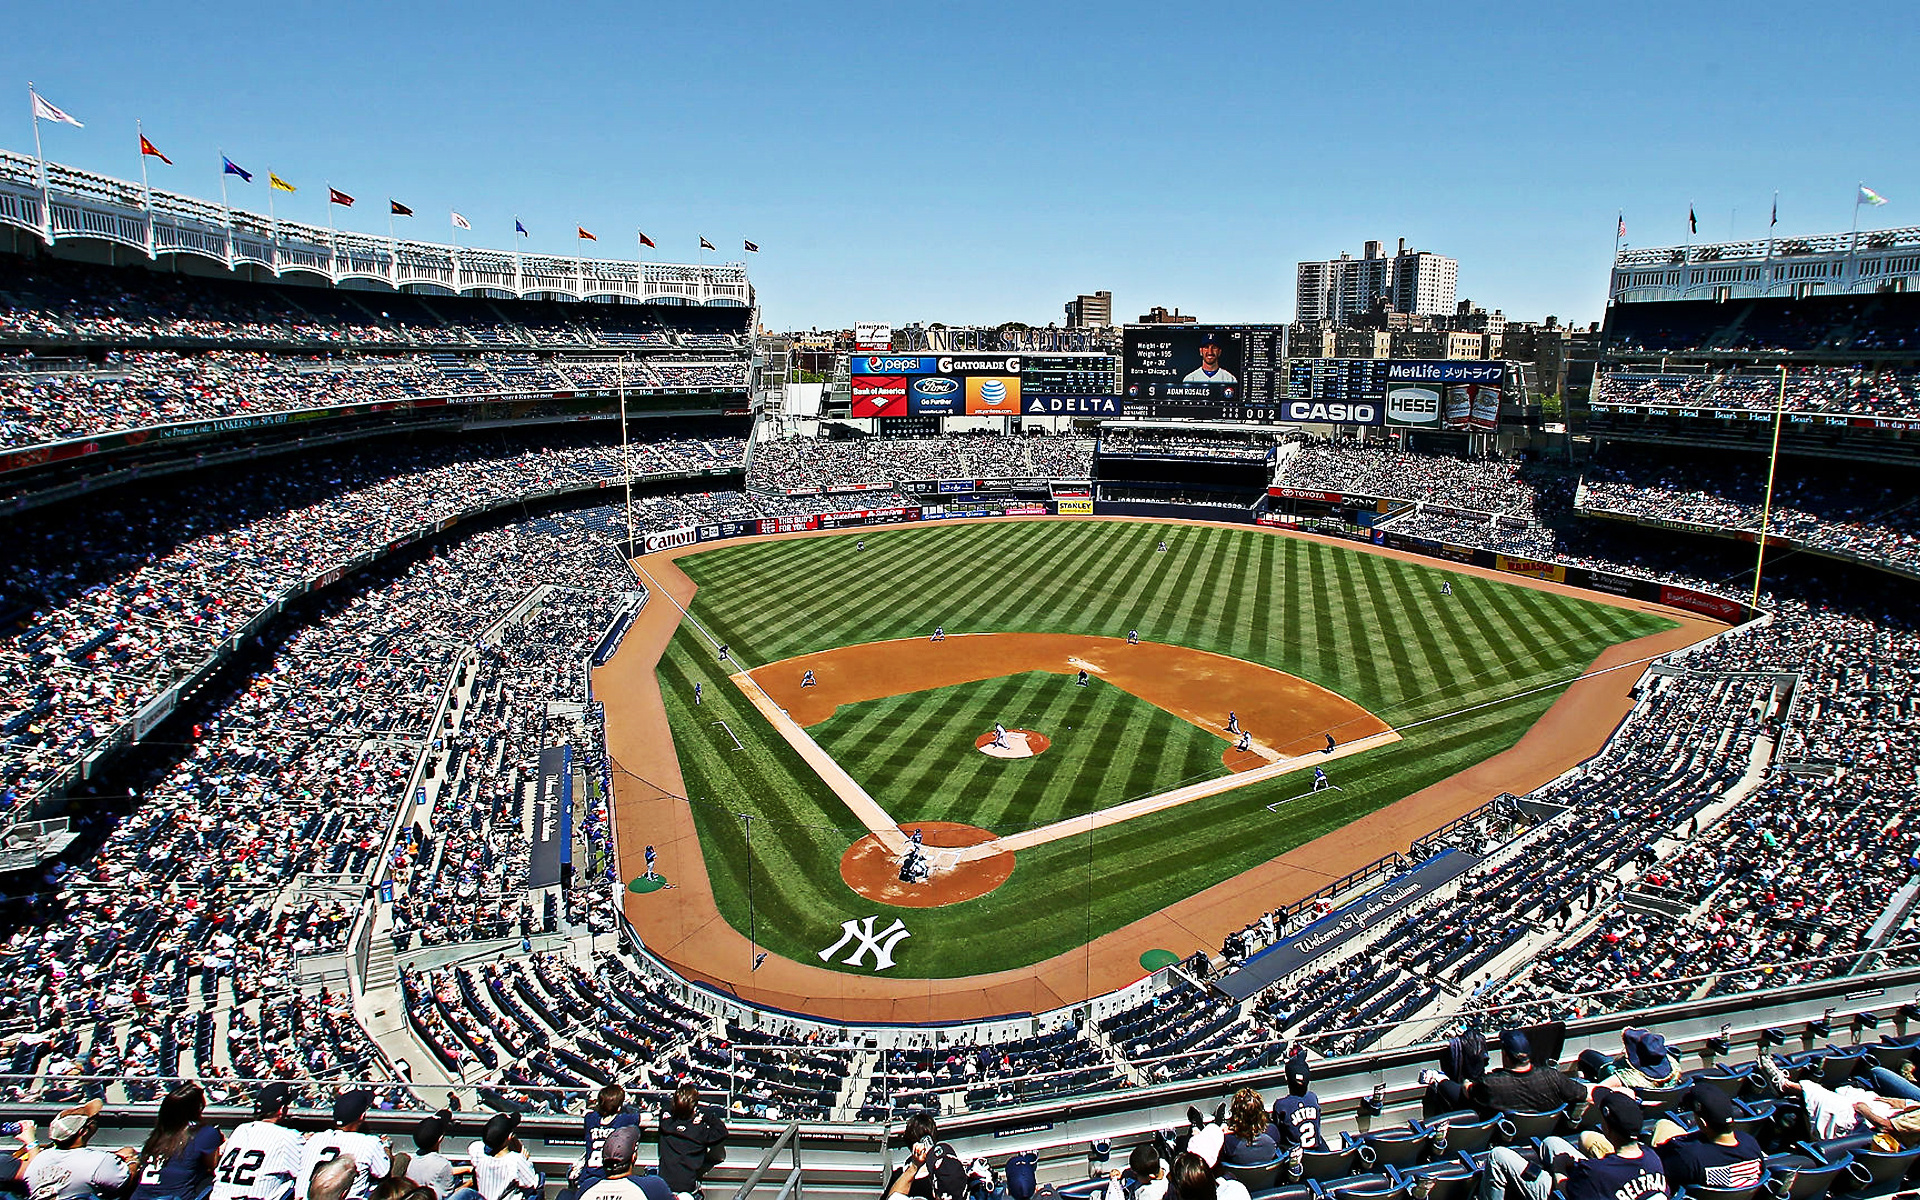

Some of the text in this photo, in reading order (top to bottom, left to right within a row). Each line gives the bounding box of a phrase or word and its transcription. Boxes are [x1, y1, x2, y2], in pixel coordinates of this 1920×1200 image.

[906, 330, 1096, 352] YANKEE STADIUM
[885, 358, 920, 371] pepsi
[953, 361, 1005, 370] GATORADE
[1389, 364, 1441, 378] MetLife
[1445, 367, 1502, 379] メットライフ
[922, 380, 951, 392] Ford
[1167, 388, 1210, 397] ADAM ROSALES
[1051, 398, 1115, 411] DELTA
[1391, 398, 1437, 412] HESS
[1289, 402, 1375, 422] CASIO
[1749, 413, 1771, 421] Head
[1826, 416, 1848, 426] Head
[1875, 420, 1889, 428] The
[1294, 490, 1325, 499] TOYOTA
[1342, 497, 1376, 506] DKNY
[778, 515, 813, 524] THIS BUD'S
[646, 530, 695, 550] Canon
[320, 569, 340, 587] AVIS
[1600, 575, 1633, 587] PlayStation
[1667, 592, 1683, 601] Bank
[1692, 598, 1718, 610] America
[1294, 883, 1421, 953] Welcome to Yankee Stadium
[1291, 1107, 1317, 1126] JETER
[1300, 1122, 1316, 1147] 2
[219, 1147, 265, 1186] 42
